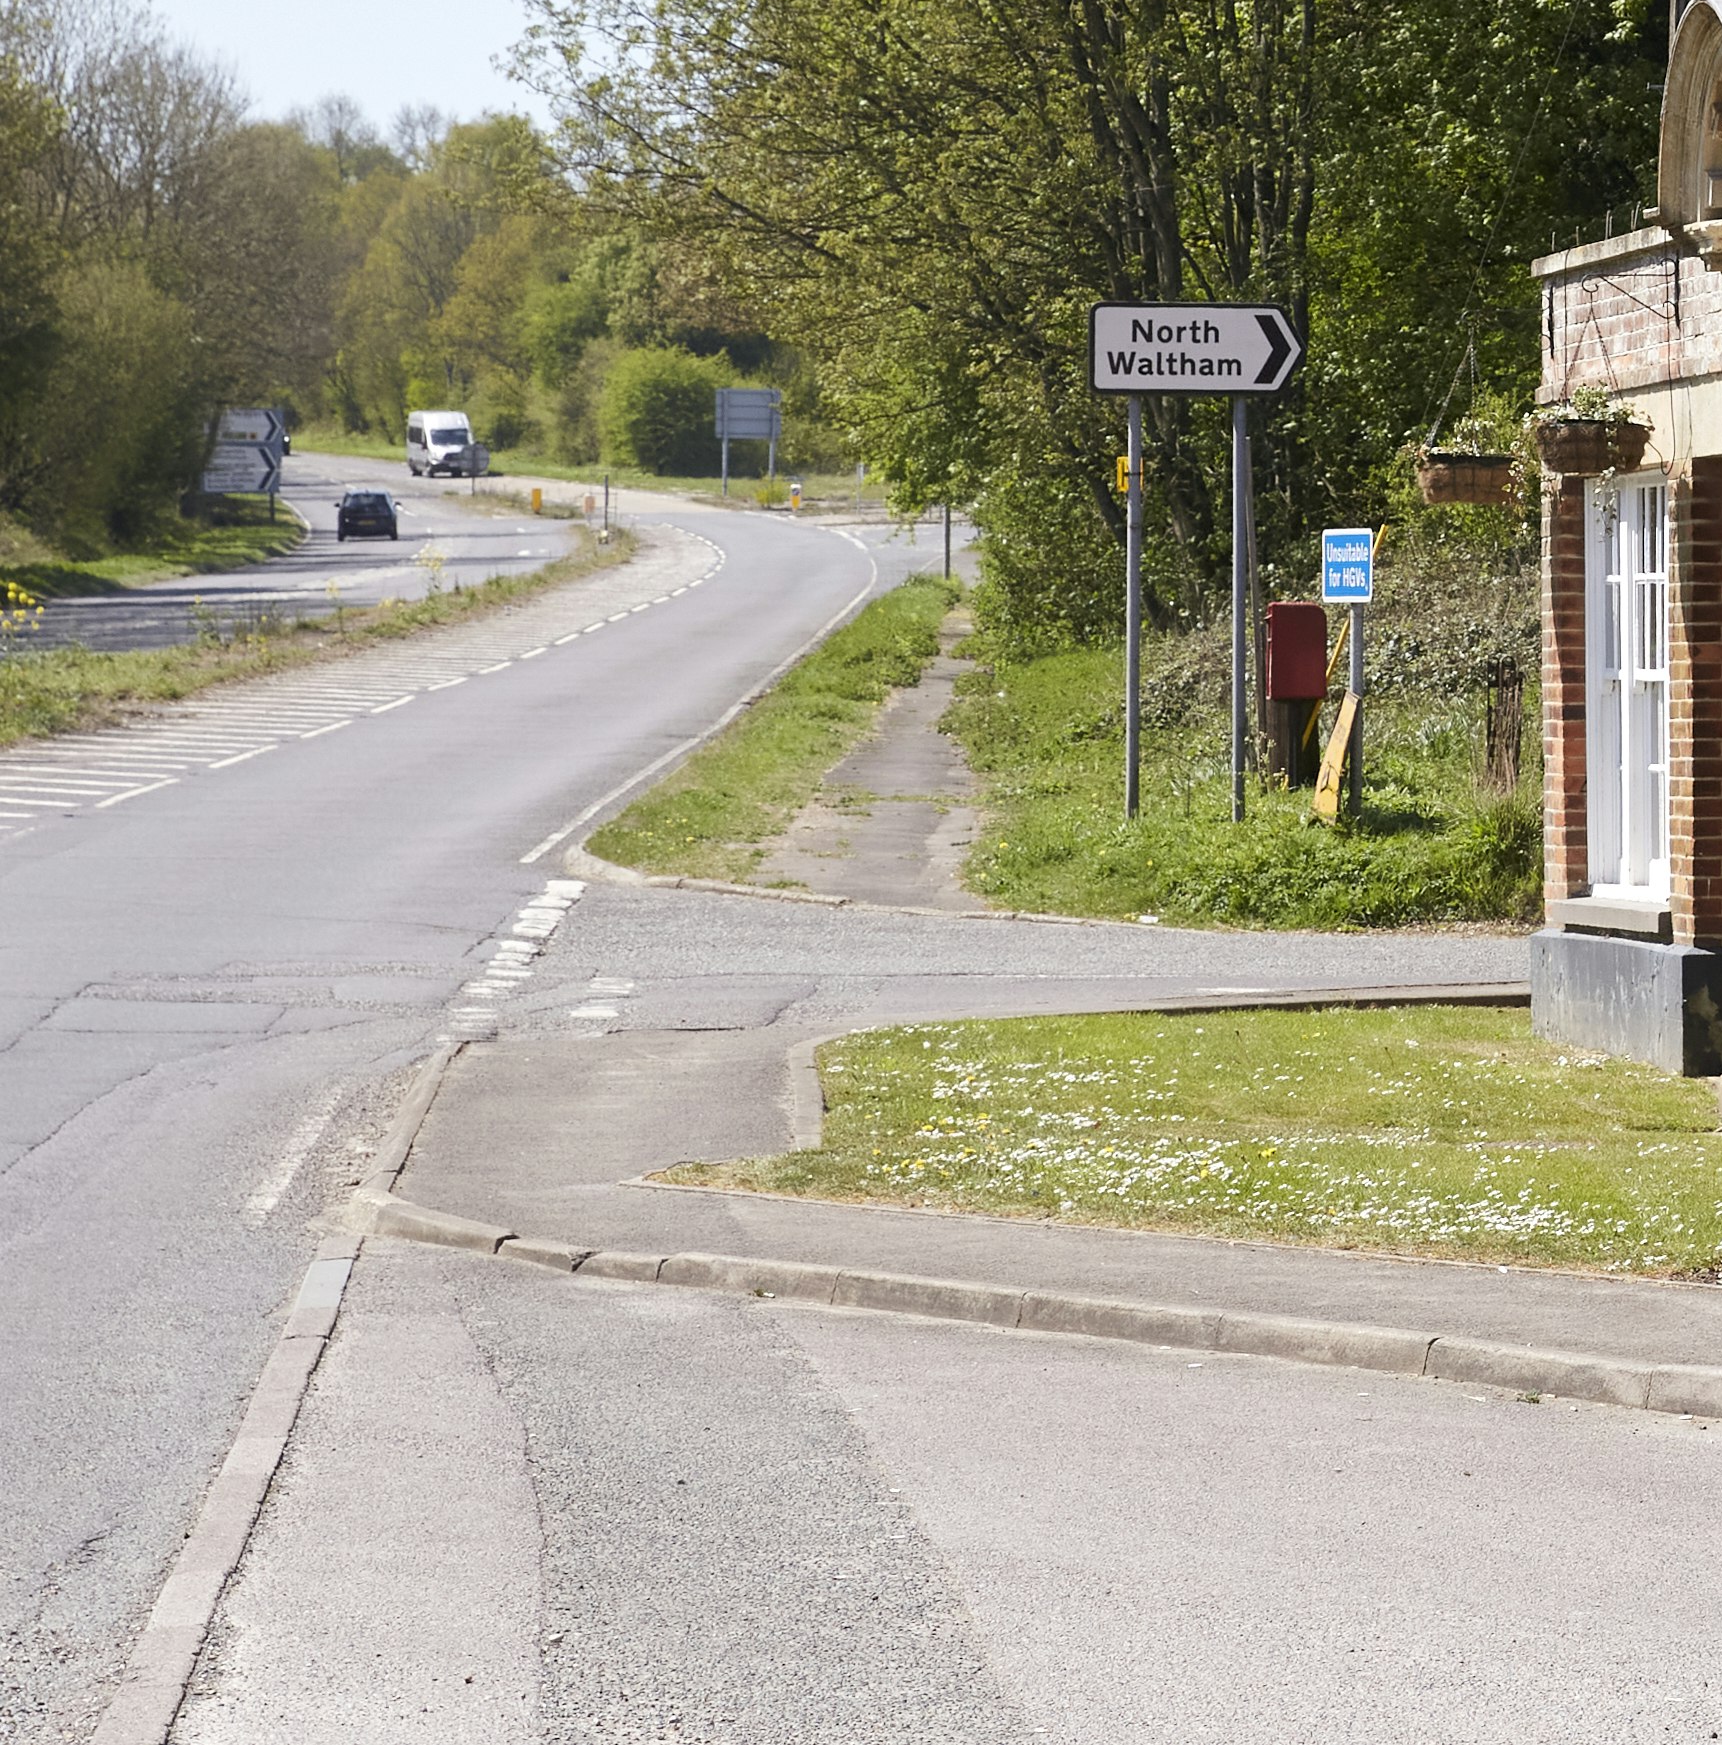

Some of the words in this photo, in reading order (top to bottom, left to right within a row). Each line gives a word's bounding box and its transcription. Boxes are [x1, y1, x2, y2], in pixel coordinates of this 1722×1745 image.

[1131, 319, 1220, 344] North
[1107, 351, 1242, 376] Waltham
[1326, 542, 1368, 562] Unsuitable
[1328, 567, 1341, 587] for
[1342, 566, 1366, 587] HGVs
